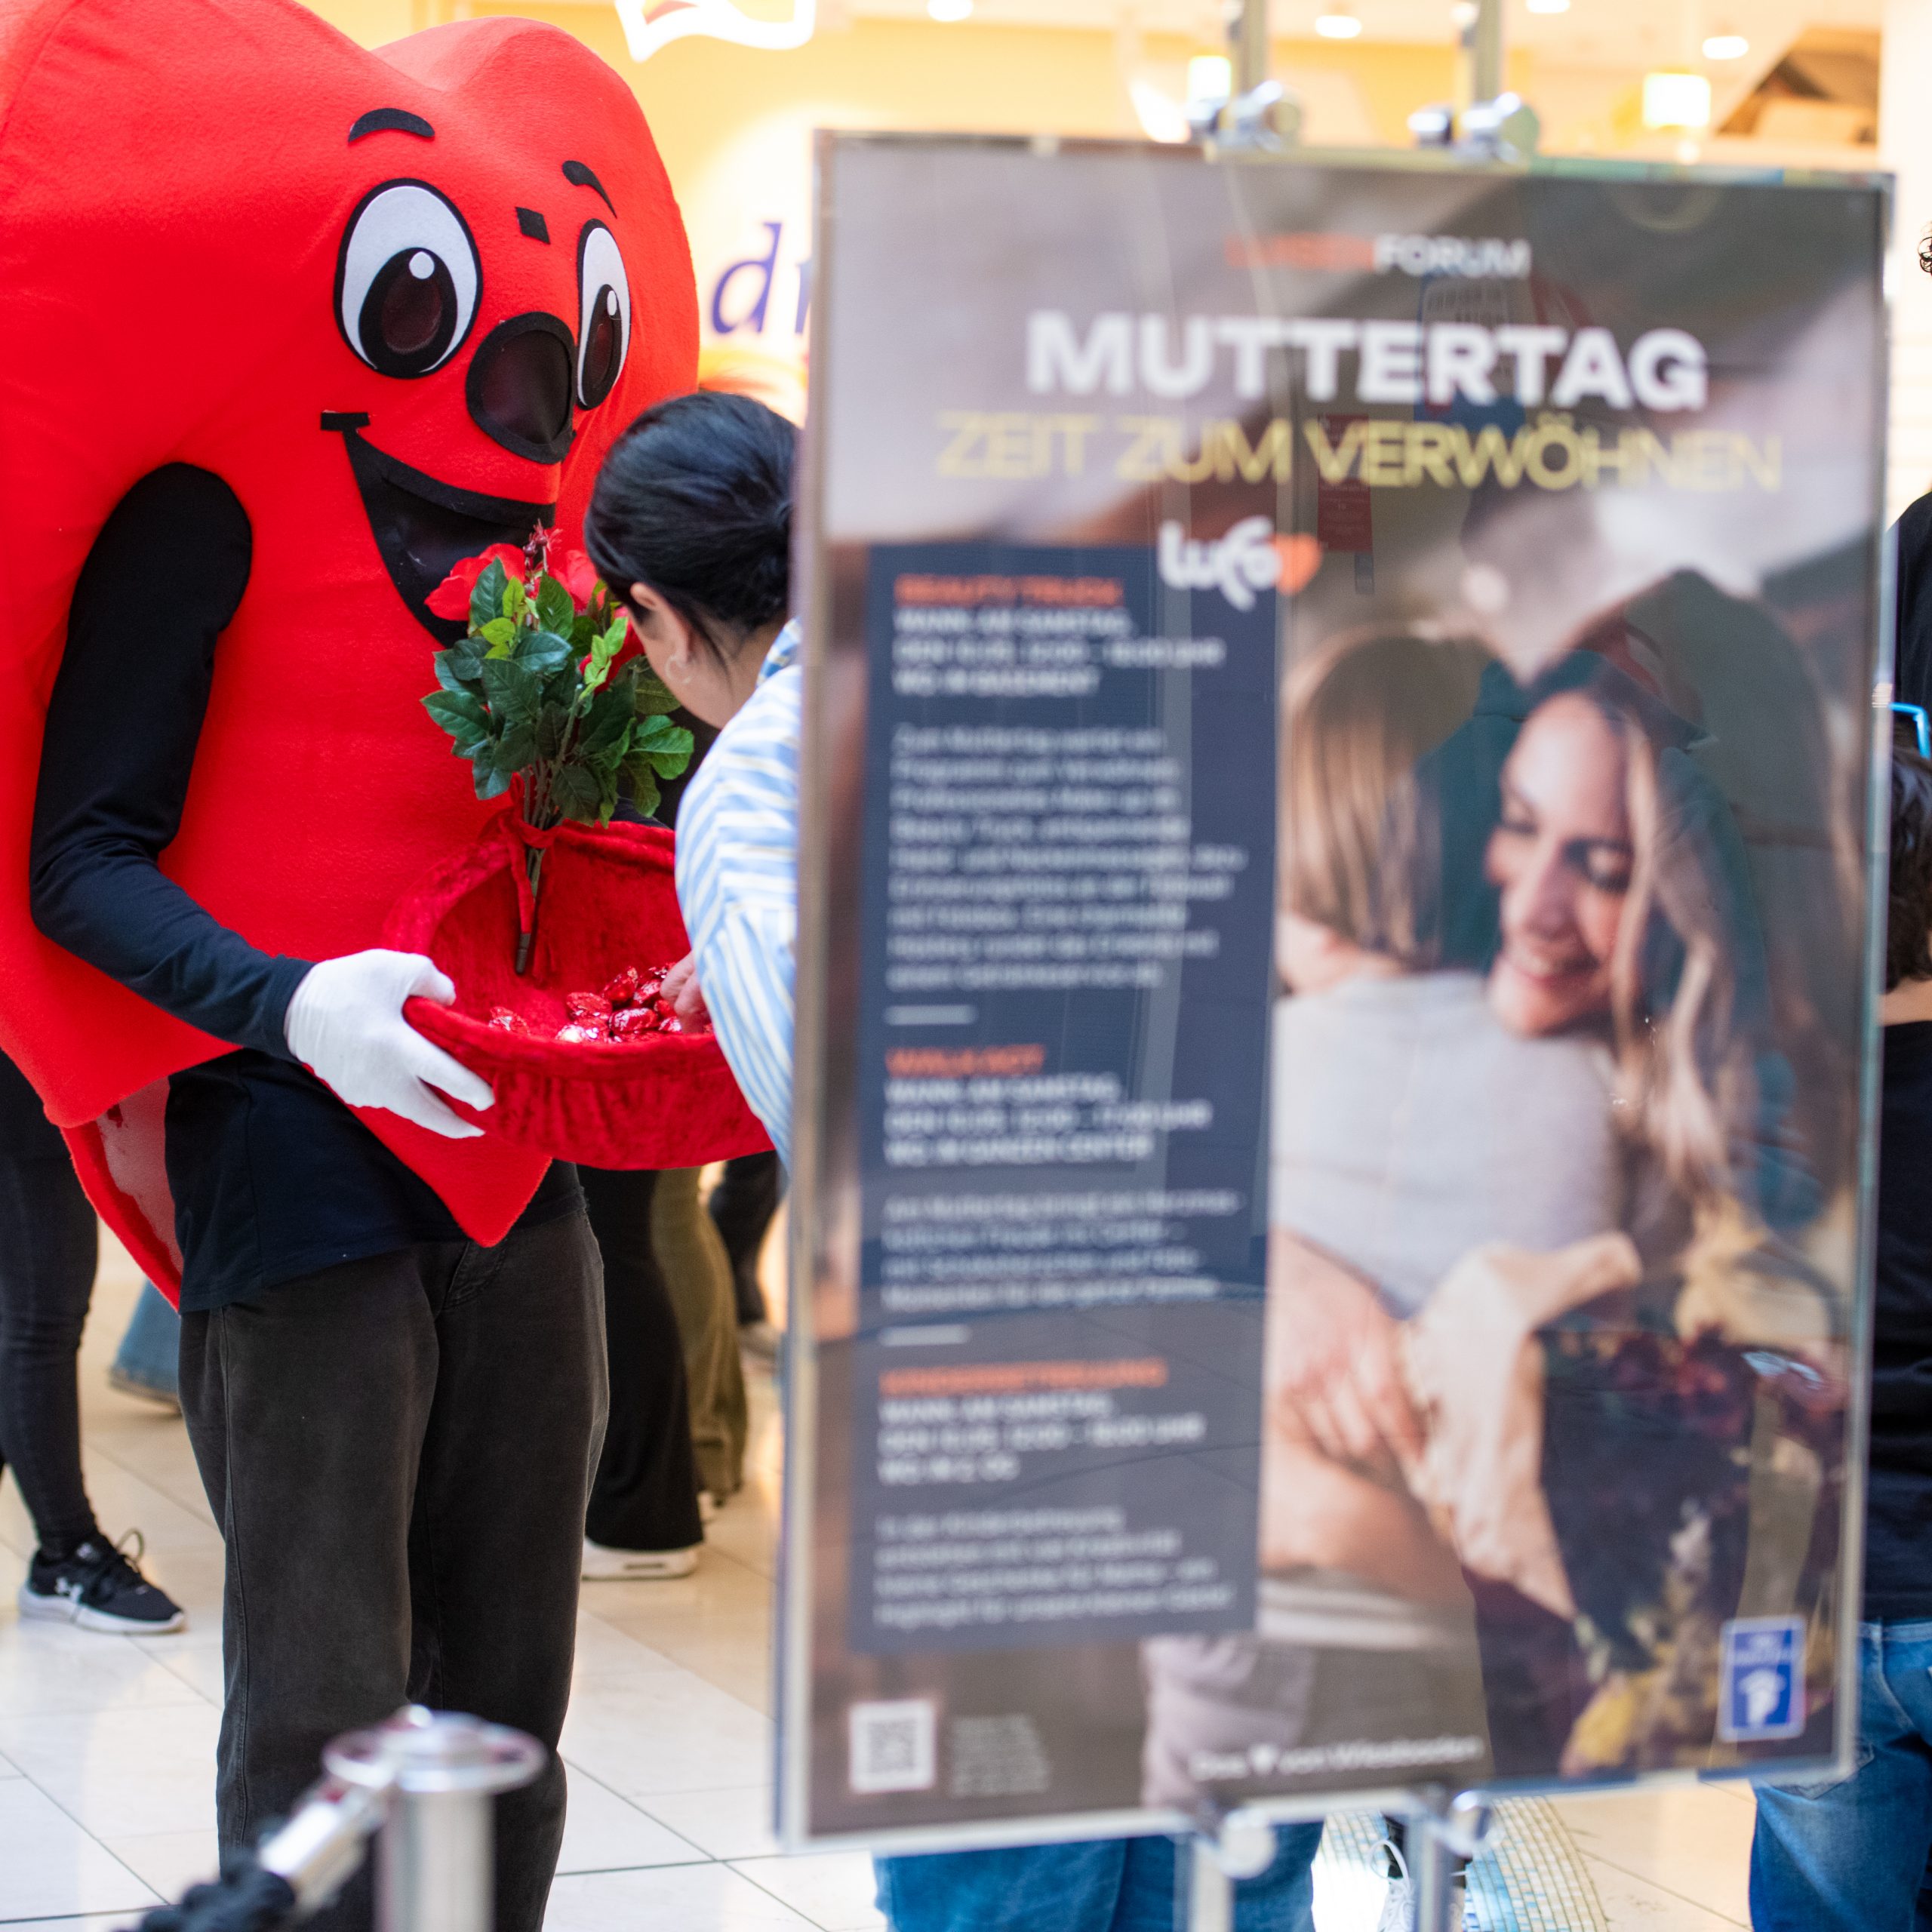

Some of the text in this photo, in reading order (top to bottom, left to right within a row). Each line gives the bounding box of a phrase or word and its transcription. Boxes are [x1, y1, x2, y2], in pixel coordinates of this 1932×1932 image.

[1027, 312, 1705, 408] MUTTERTAG
[937, 411, 1783, 491] ZEIT ZUM VERWÖHNEN
